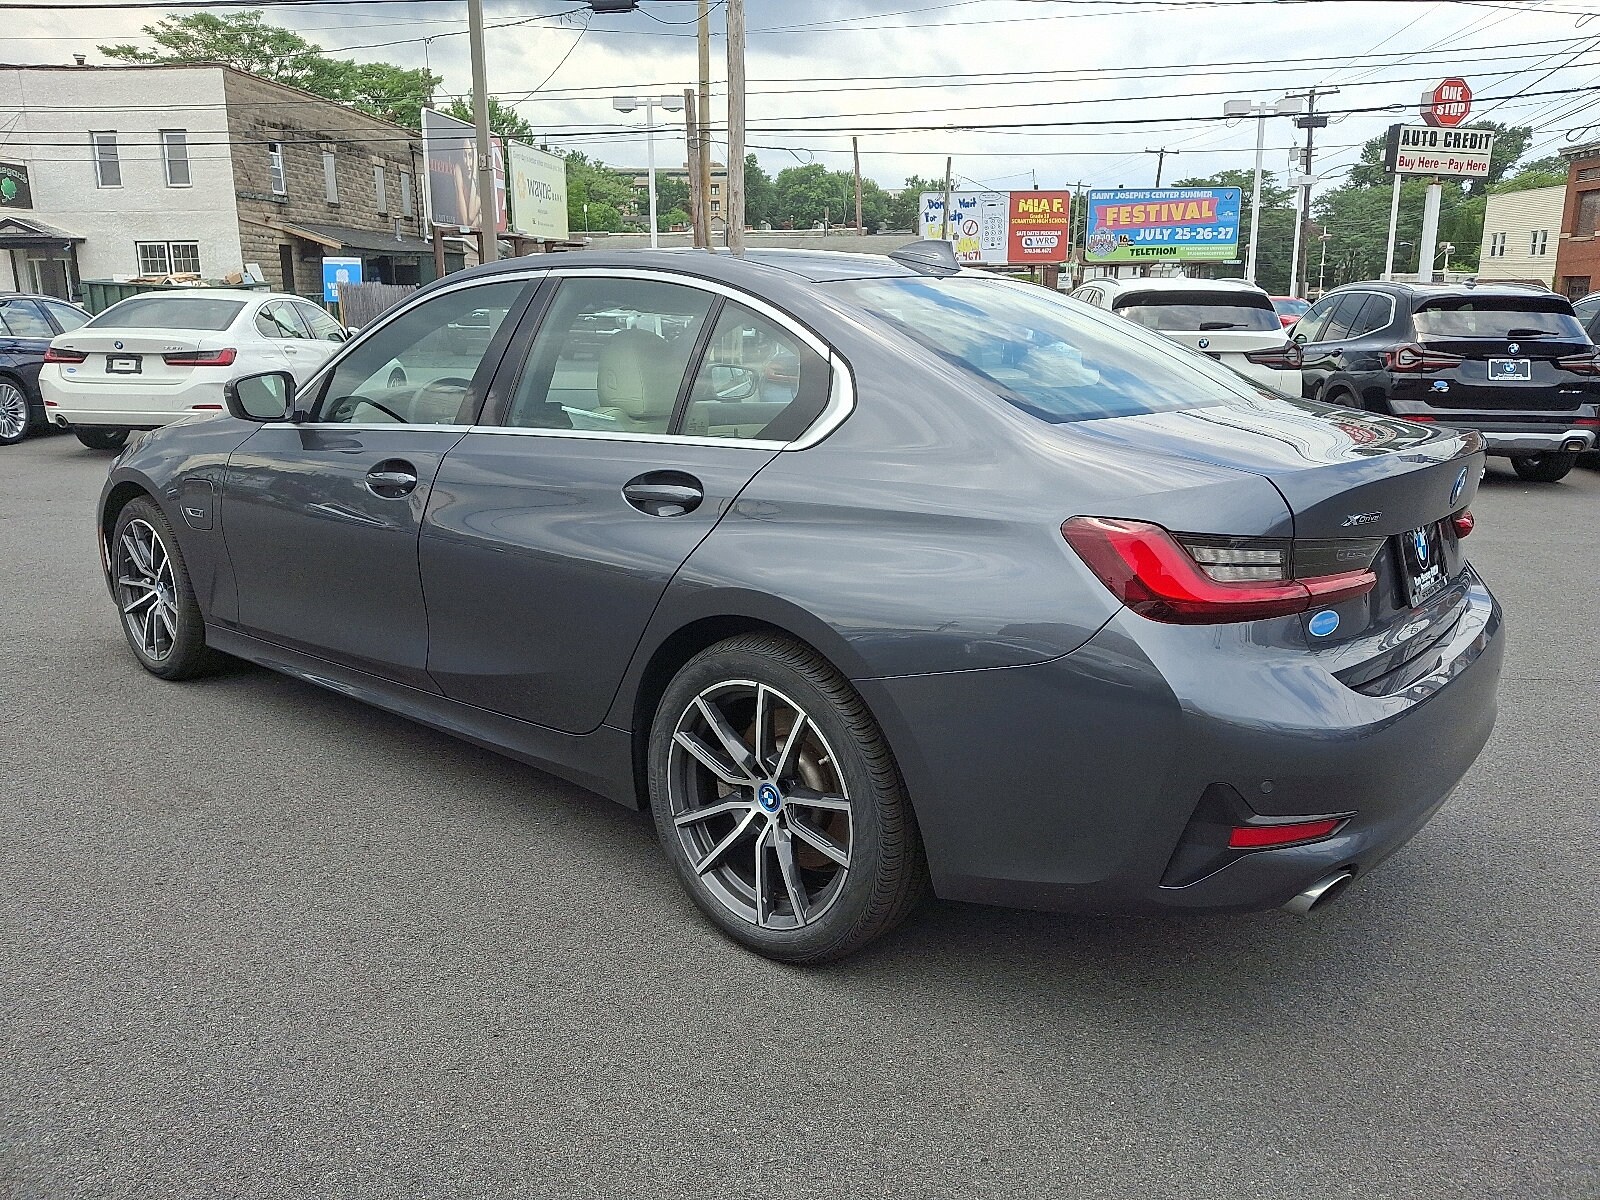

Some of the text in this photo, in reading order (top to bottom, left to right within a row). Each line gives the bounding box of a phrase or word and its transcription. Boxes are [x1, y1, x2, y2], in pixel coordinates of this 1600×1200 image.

[1441, 86, 1463, 100] ONE
[1436, 102, 1466, 116] STOP
[1401, 129, 1492, 149] AUTO CREDIT
[1398, 156, 1416, 170] Buy
[1417, 156, 1439, 169] Here
[1448, 158, 1465, 172] Pay
[1466, 159, 1487, 172] Here
[527, 178, 552, 203] wayne
[1091, 190, 1213, 200] SAINT JOSEPH'S CENTER SUMMER
[1018, 198, 1064, 213] MIA F.
[1106, 200, 1213, 226] FESTIVAL
[1035, 236, 1056, 245] WRC
[1135, 227, 1234, 241] JULY 25-26-27
[1129, 247, 1177, 257] TELETHON
